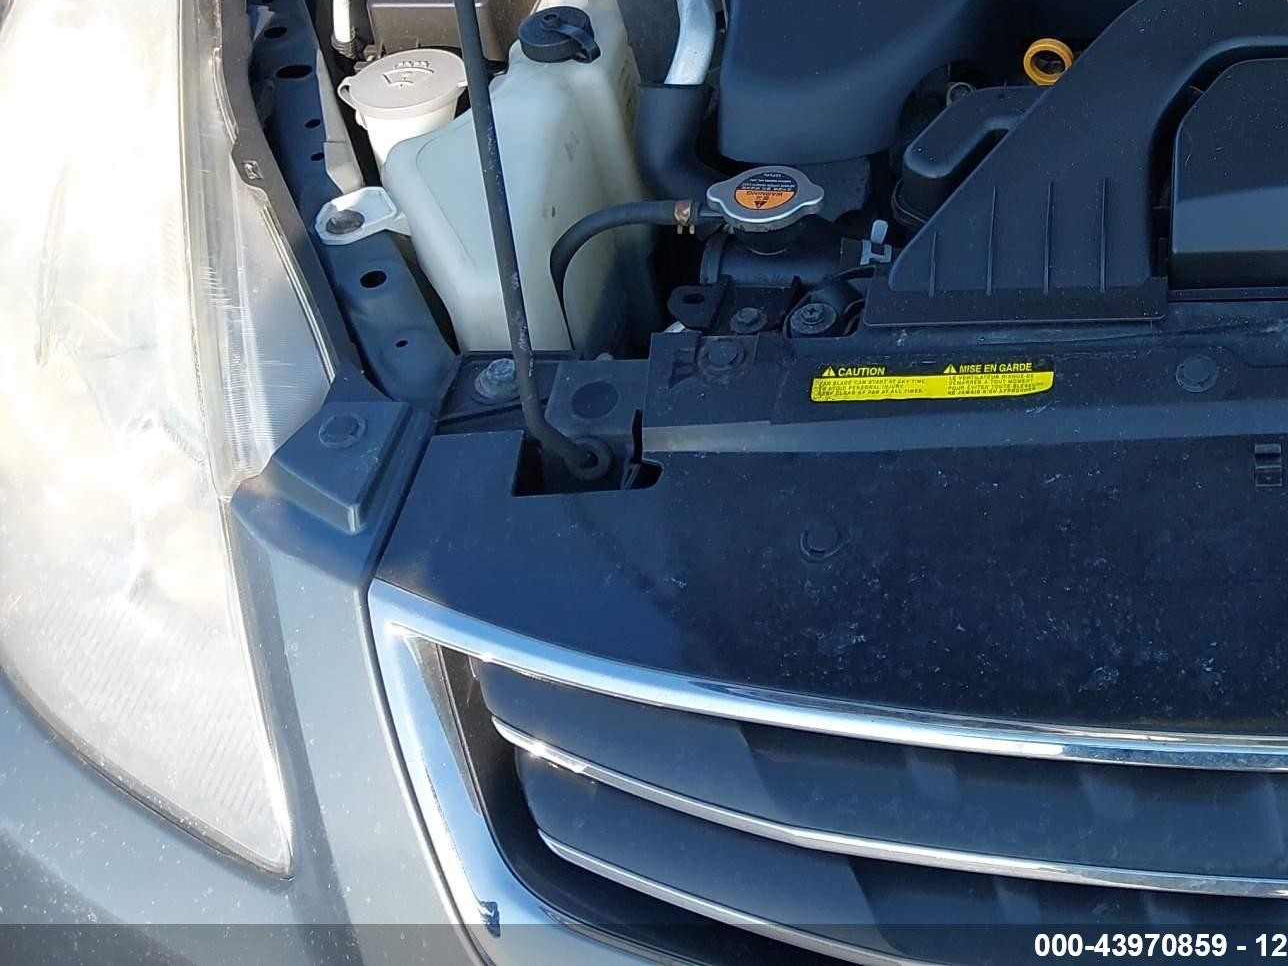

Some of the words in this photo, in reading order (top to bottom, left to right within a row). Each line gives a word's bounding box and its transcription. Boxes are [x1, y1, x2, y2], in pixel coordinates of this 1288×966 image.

[838, 367, 885, 376] CAUTION
[959, 364, 982, 373] MISE
[984, 363, 997, 373] EN
[999, 363, 1033, 372] GARDE
